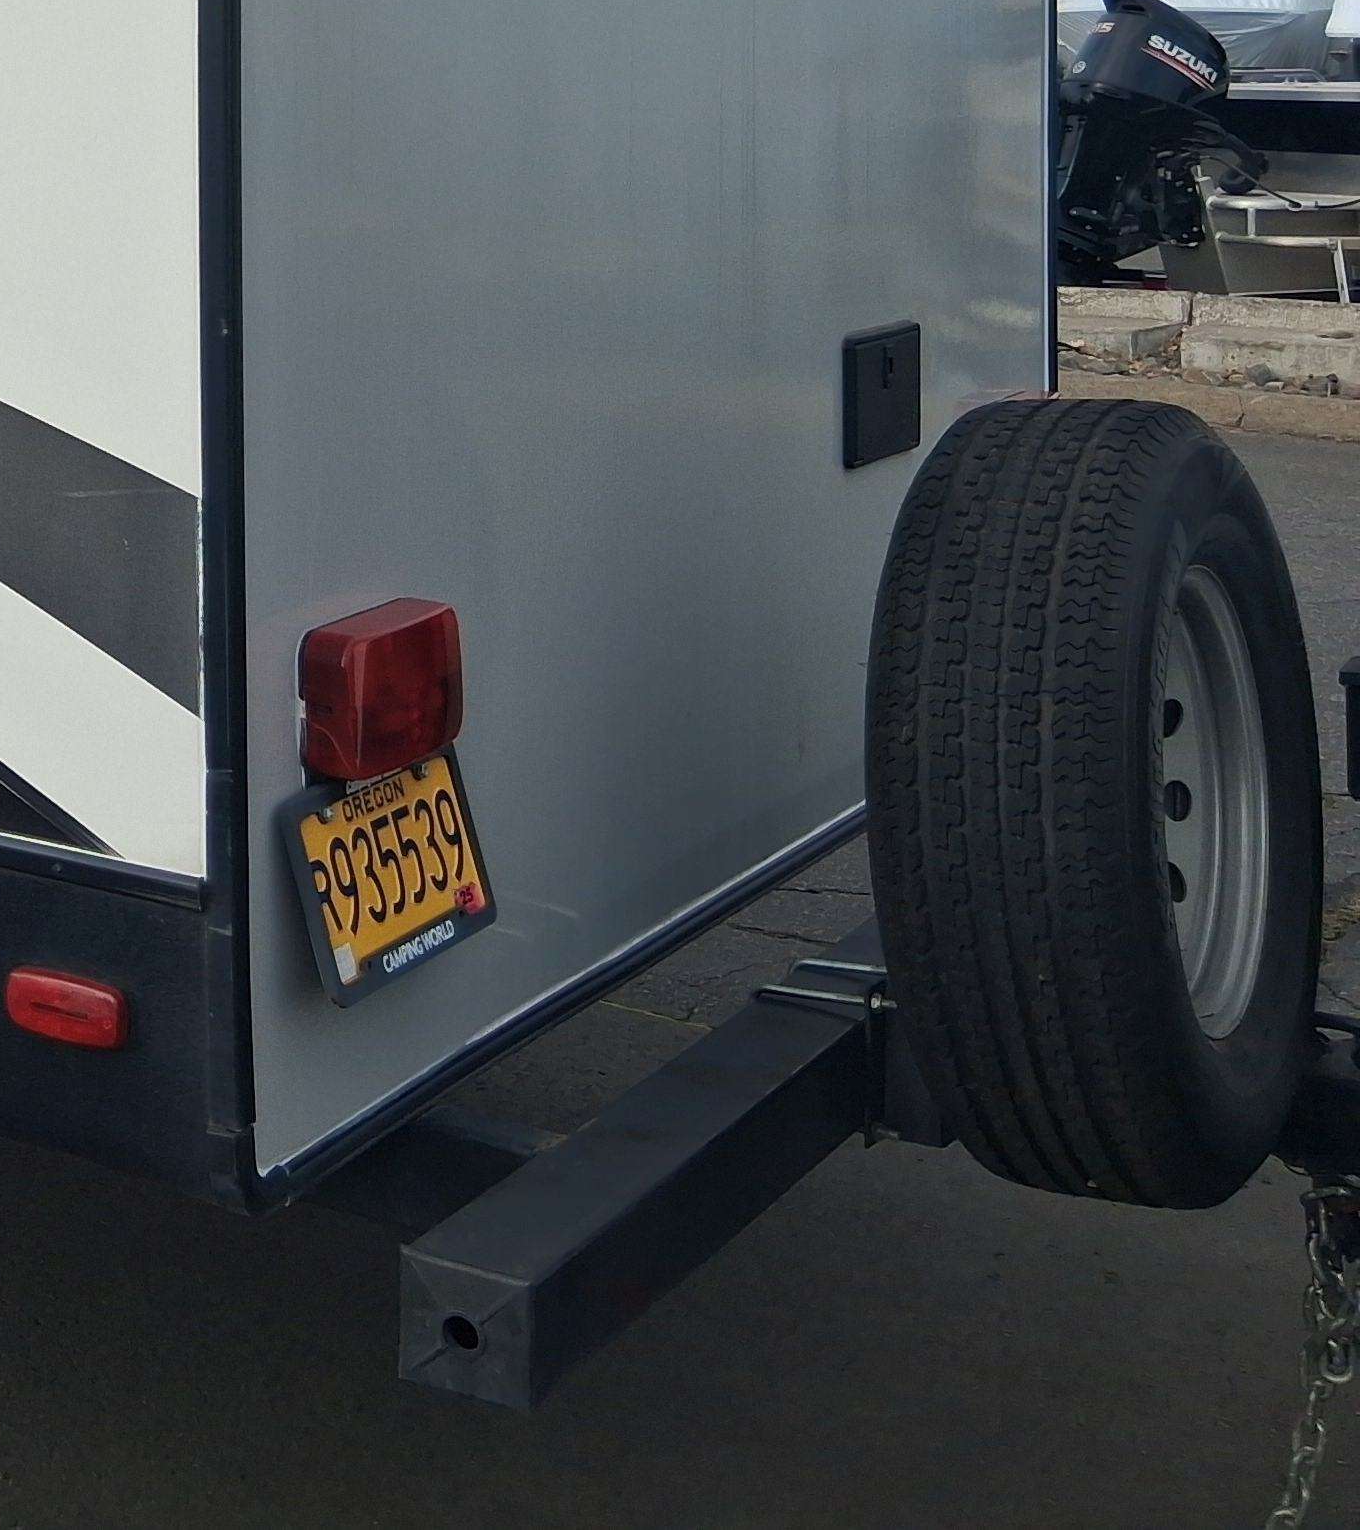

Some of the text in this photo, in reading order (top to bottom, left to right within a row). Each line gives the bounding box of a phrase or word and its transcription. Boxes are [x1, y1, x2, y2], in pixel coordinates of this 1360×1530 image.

[1147, 34, 1218, 83] SUZUKI
[342, 778, 404, 821] OREGON
[309, 789, 464, 935] R935539
[459, 886, 474, 905] 25
[382, 919, 455, 973] CAMPING WORLD
